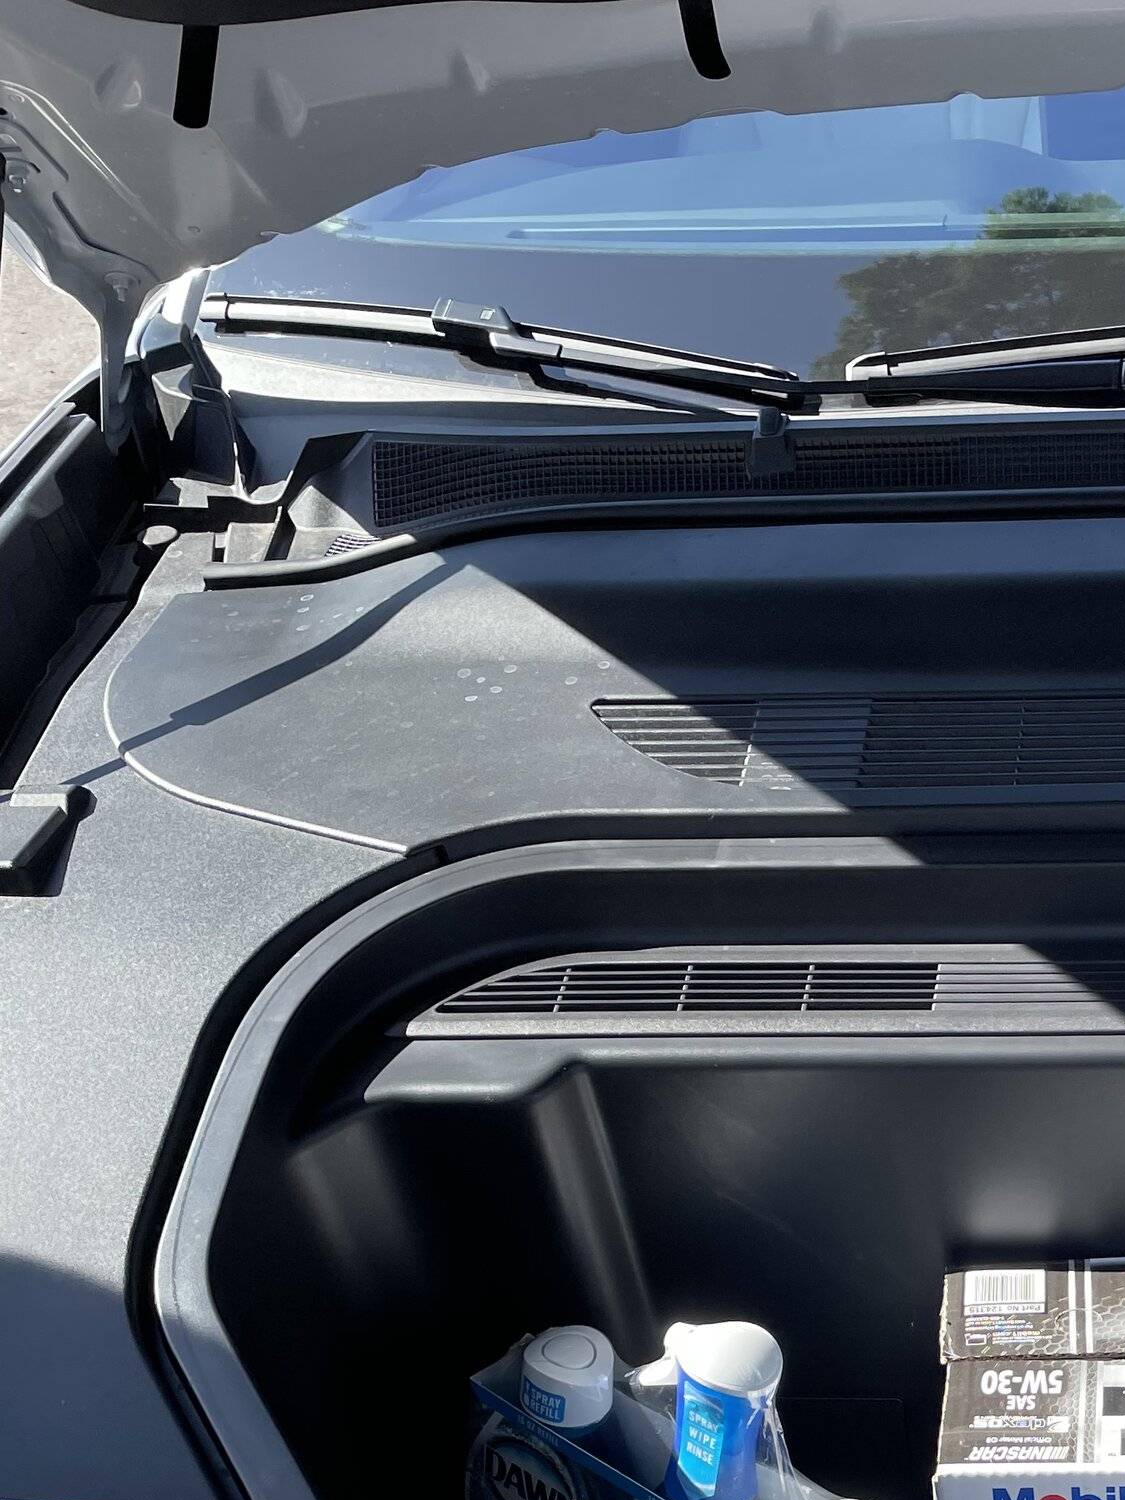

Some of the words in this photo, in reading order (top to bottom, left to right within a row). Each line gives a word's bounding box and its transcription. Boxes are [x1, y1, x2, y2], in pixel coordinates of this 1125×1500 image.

[981, 1370, 1063, 1394] 5W-30
[530, 1389, 561, 1408] SPRAY
[1006, 1395, 1036, 1410] SAE
[530, 1400, 560, 1419] REFILL
[688, 1411, 718, 1433] SPRAY
[689, 1426, 717, 1450] WIPE
[686, 1441, 713, 1465] RINSE
[968, 1446, 1045, 1460] NASCAR
